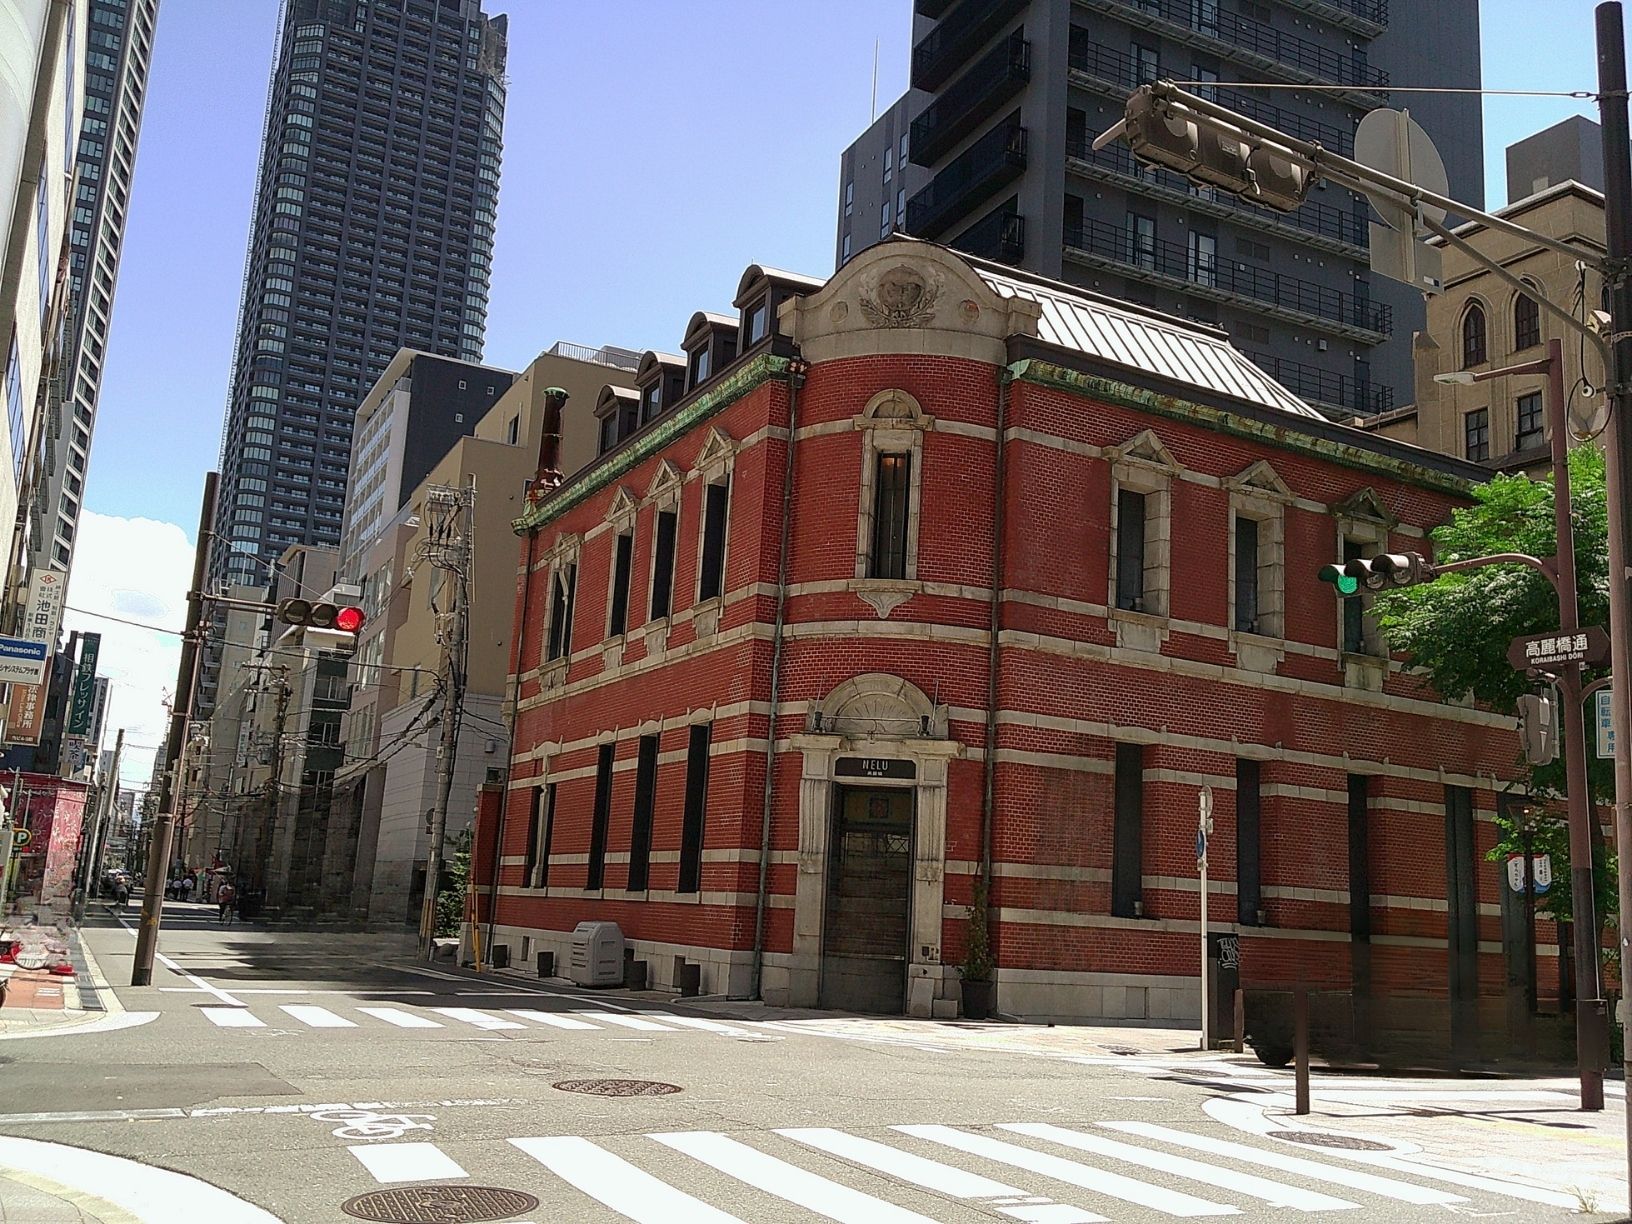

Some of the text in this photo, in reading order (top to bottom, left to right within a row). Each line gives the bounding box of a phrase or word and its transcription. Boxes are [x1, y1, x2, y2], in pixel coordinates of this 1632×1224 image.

[32, 600, 51, 642] 池田商
[0, 643, 41, 656] Panasonic
[1525, 634, 1588, 658] 高麗橋通
[1531, 655, 1567, 665] KORAIBASHI
[863, 760, 888, 770] NELU
[18, 832, 27, 843] P
